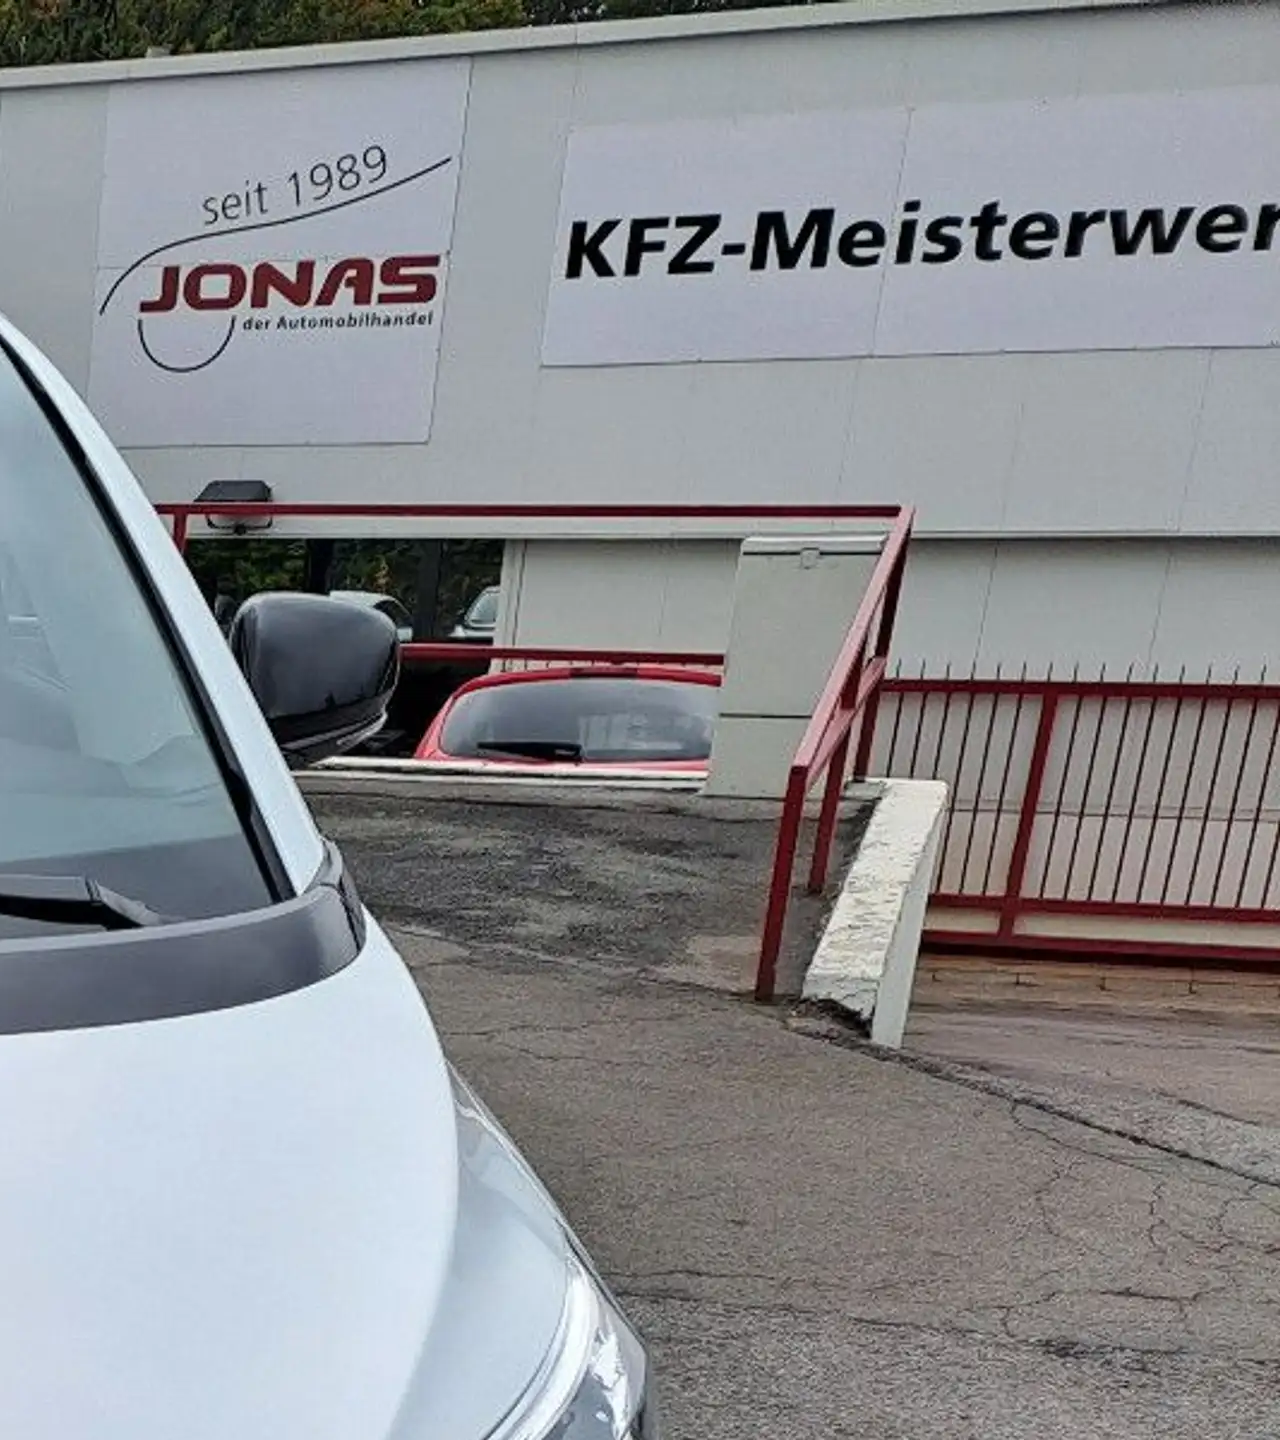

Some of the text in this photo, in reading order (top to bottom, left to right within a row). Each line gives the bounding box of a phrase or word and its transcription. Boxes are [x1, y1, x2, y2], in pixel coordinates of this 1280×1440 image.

[202, 144, 388, 225] seit 1989
[564, 200, 1280, 279] KFZ-Meisterwer
[139, 255, 441, 313] JONAS
[243, 311, 434, 331] der Automobilhandel
